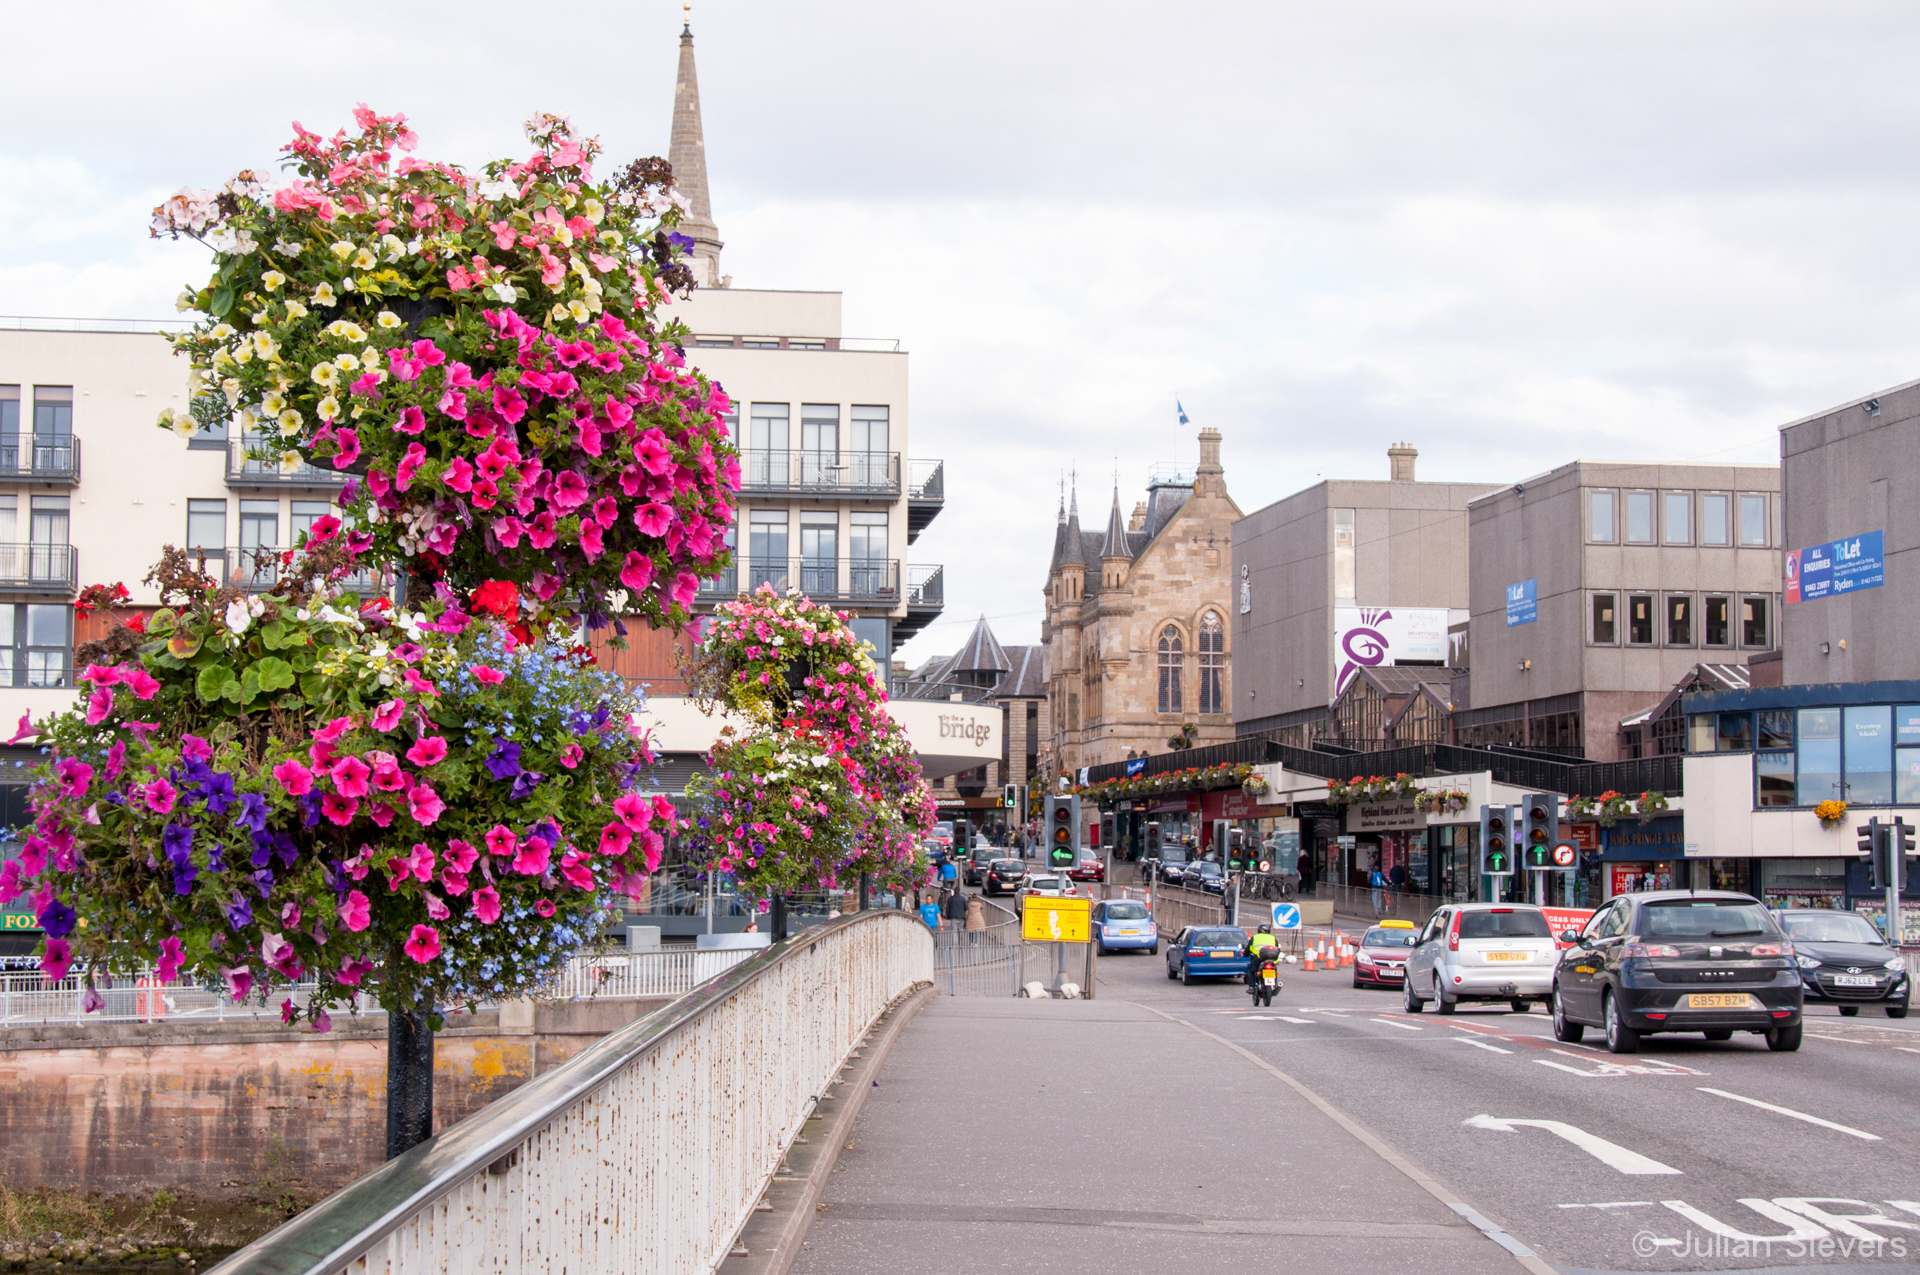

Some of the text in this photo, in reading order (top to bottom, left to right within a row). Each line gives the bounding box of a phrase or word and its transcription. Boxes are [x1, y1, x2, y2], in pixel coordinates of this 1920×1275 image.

[1812, 549, 1822, 559] ALL
[1804, 558, 1830, 573] ENQUIRIES
[938, 715, 990, 747] bridge
[1229, 794, 1242, 806] pound
[1229, 805, 1248, 816] stretcher
[1361, 804, 1415, 819] Highland House of Fraser
[1610, 834, 1631, 846] JAMES
[1633, 833, 1663, 845] PRINGLE
[1693, 996, 1746, 1005] SB57 BZM
